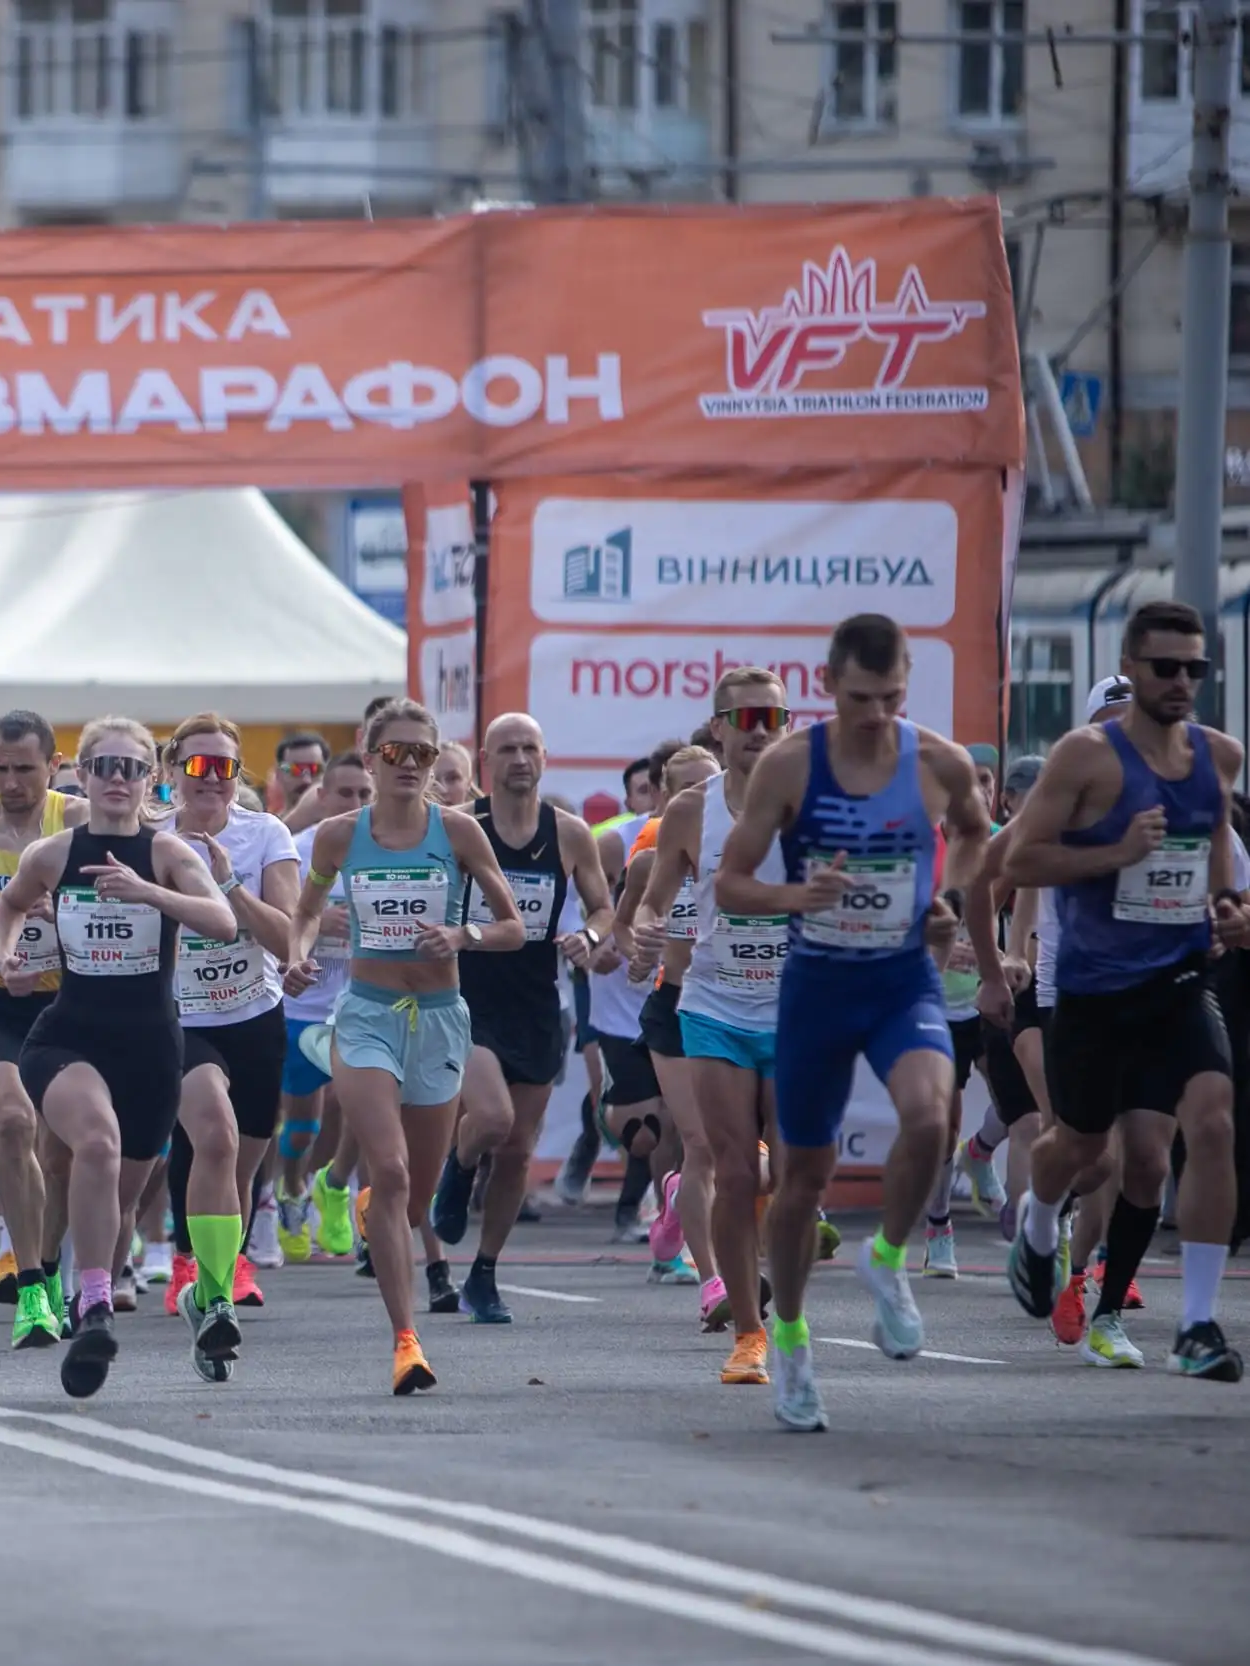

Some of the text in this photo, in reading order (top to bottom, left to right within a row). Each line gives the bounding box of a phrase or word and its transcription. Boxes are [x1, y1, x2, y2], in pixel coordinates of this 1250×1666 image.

[727, 317, 956, 392] VFT
[706, 390, 985, 415] VINNYTSIA TRIATHLON FEDERATION
[657, 555, 934, 588] ВІННИЦЯБУД
[1146, 870, 1193, 887] 1217
[371, 899, 427, 916] 1216
[84, 922, 133, 940] 1115
[378, 926, 413, 937] RUN
[91, 950, 123, 961] RUN
[193, 959, 248, 981] 1070
[745, 968, 775, 980] RUN
[211, 987, 238, 1001] RUN
